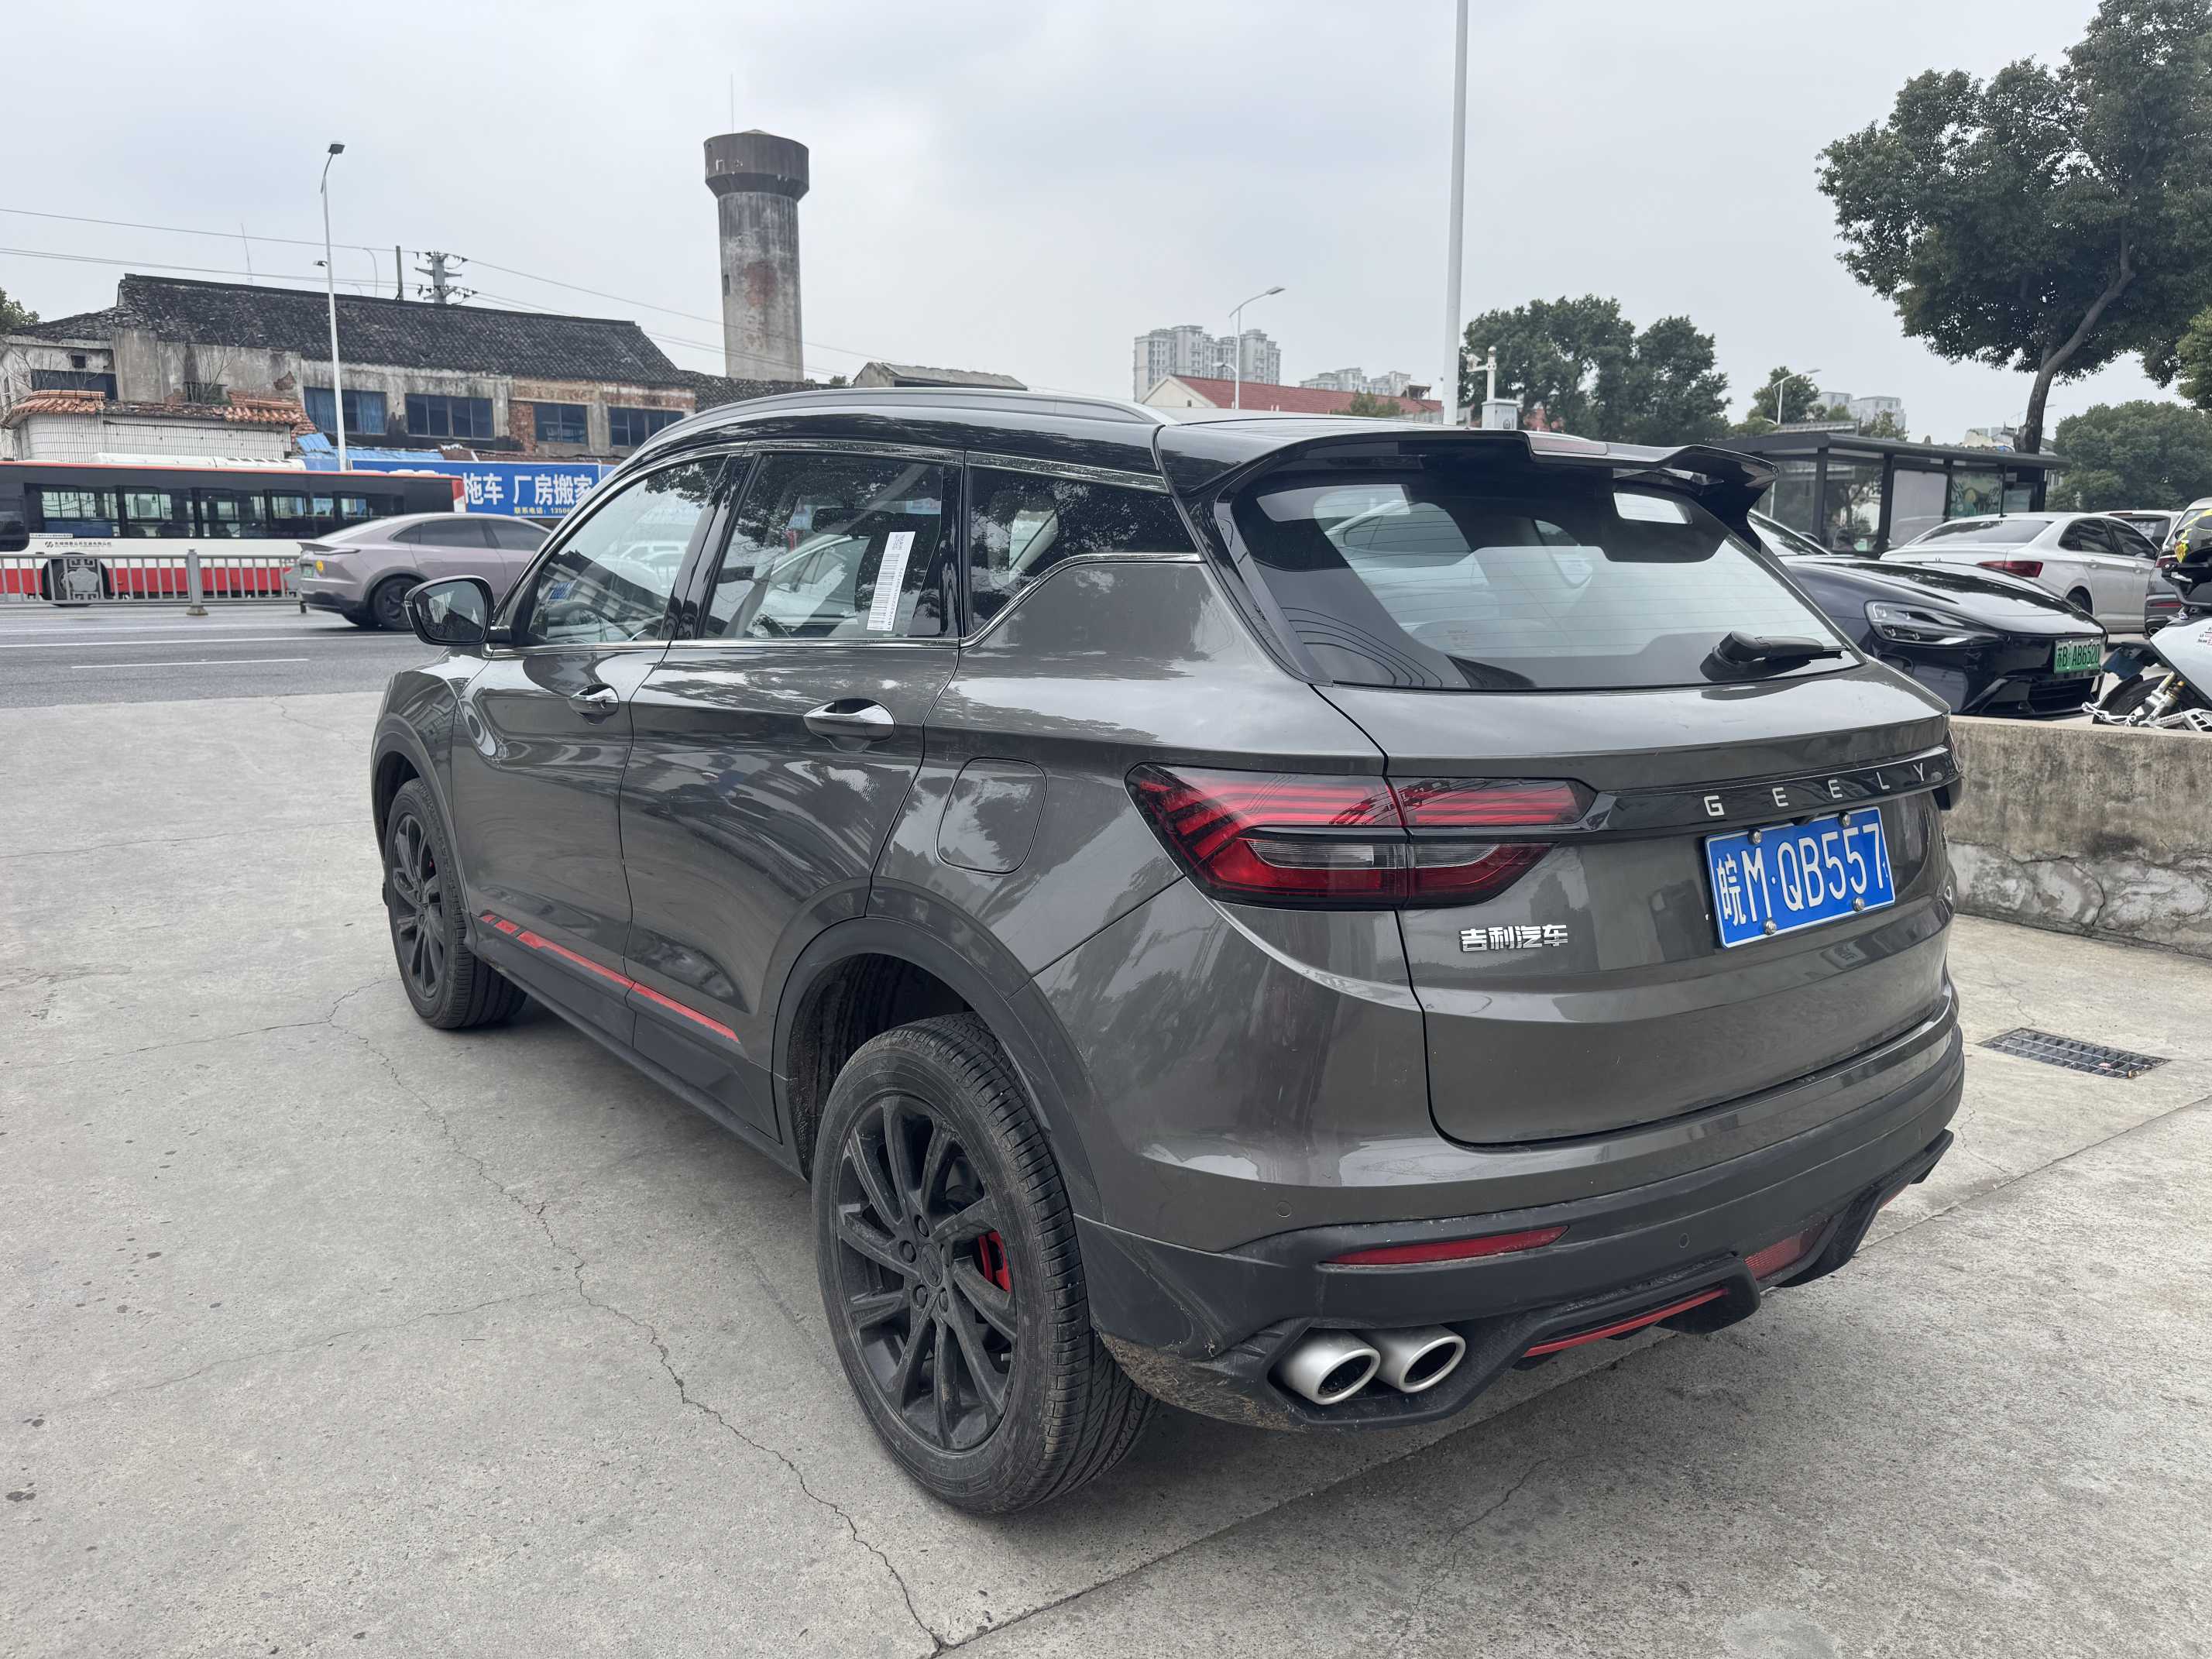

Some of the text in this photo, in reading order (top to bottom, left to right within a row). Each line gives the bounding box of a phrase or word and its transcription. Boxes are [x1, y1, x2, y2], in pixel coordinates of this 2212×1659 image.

[463, 472, 592, 505] 拖车 厂房搬家
[1704, 763, 1925, 816] GEELY
[1460, 924, 1568, 952] 吉利汽车
